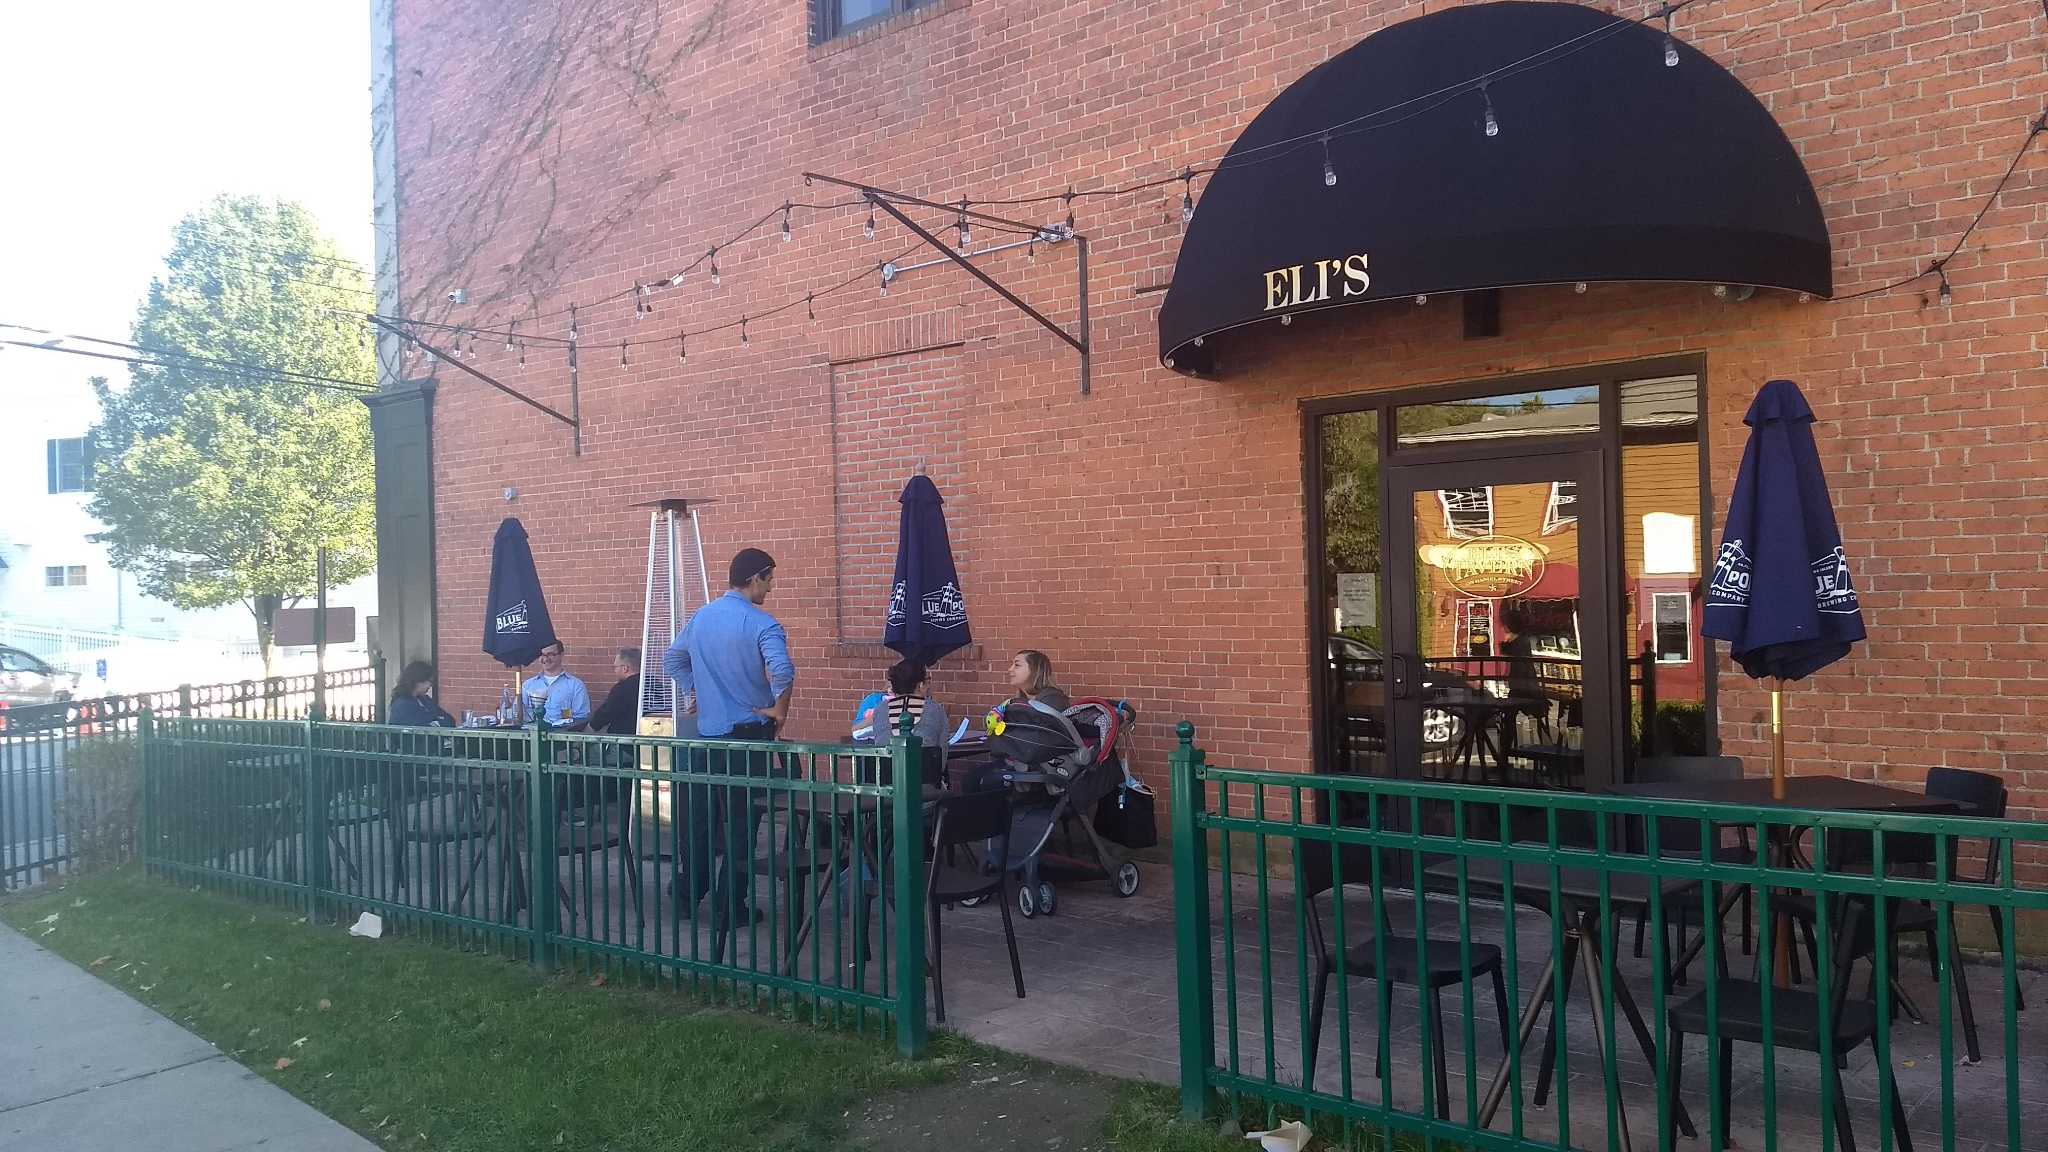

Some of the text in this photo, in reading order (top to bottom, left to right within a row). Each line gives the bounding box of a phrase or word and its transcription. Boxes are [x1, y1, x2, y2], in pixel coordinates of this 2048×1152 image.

[1264, 254, 1370, 311] ELI'S
[1453, 559, 1536, 581] TAVERN
[1711, 590, 1744, 603] COMPANY
[496, 614, 522, 630] BLUE
